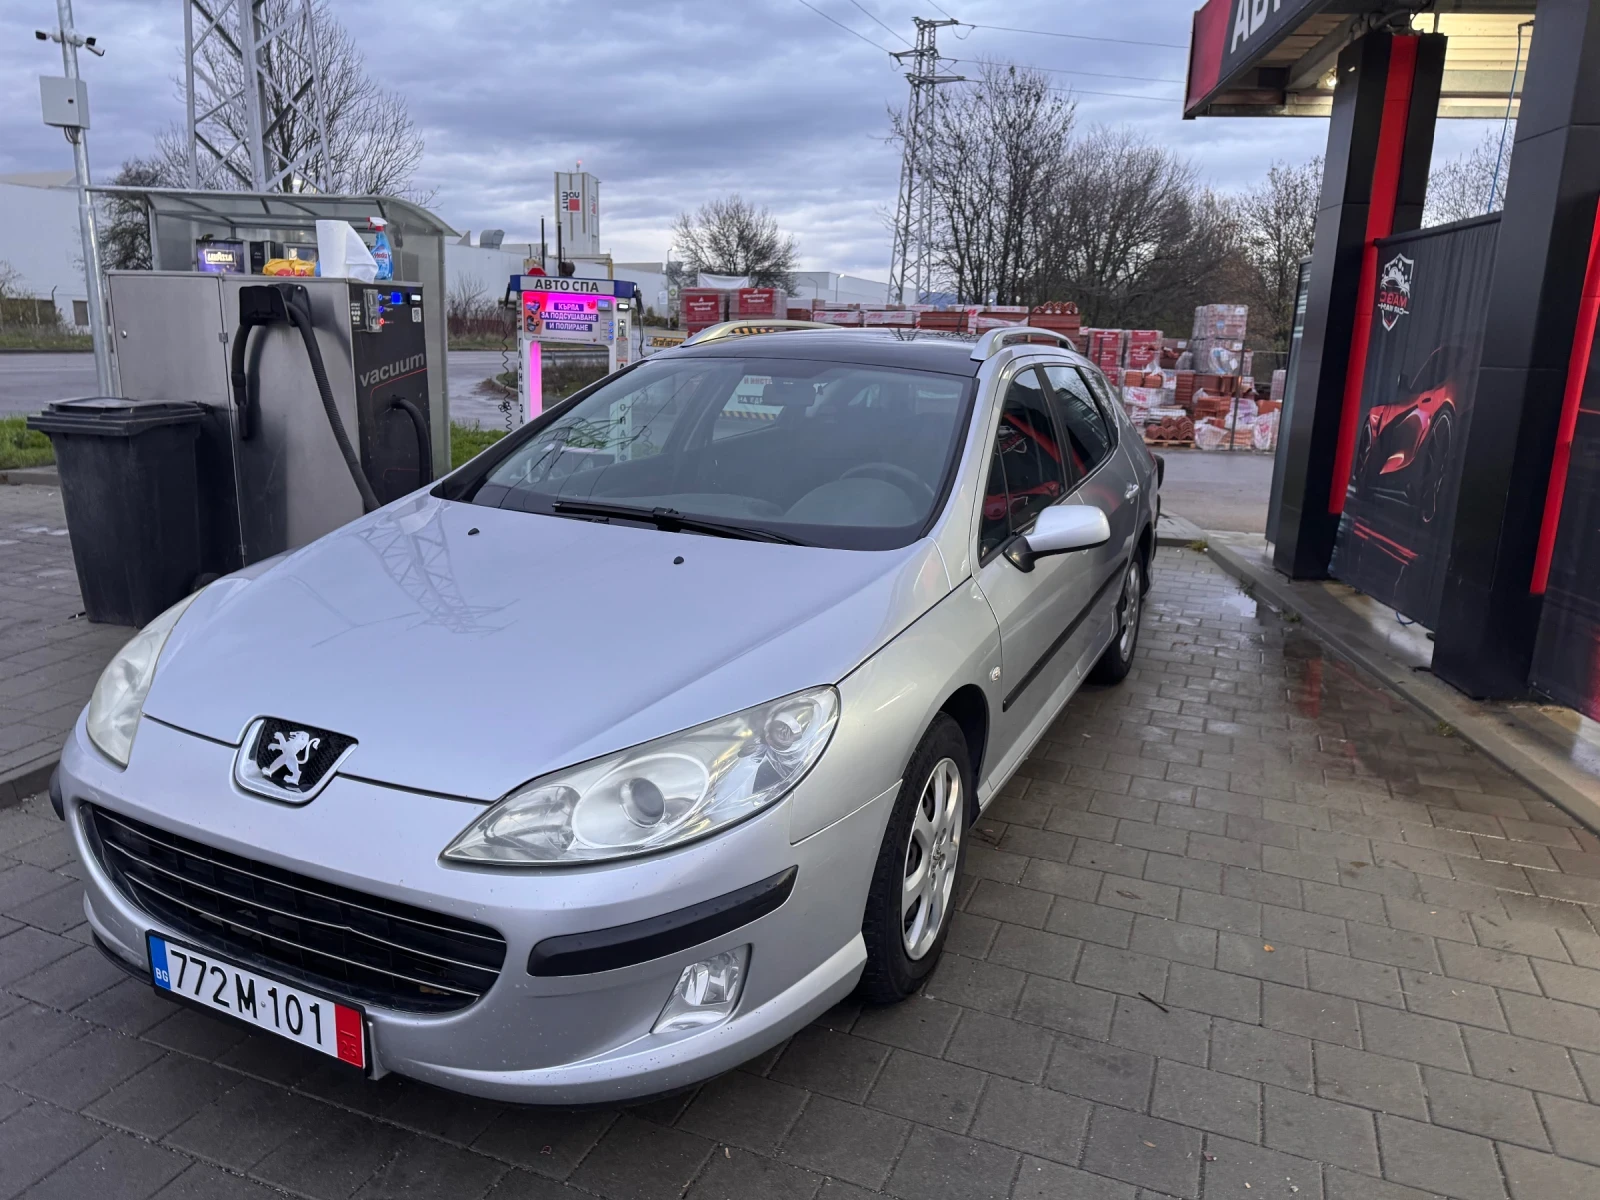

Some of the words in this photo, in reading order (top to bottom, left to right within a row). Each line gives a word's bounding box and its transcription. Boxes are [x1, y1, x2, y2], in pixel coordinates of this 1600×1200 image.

[534, 279, 570, 291] АВТО
[572, 281, 599, 292] СПА
[558, 303, 580, 311] КЪРПА
[540, 311, 550, 319] ЗА
[550, 312, 597, 321] ПОДСУШАВАНЕ
[555, 322, 589, 331] ПОЛИРАНЕ
[360, 353, 425, 387] vacuum
[155, 967, 169, 983] BG
